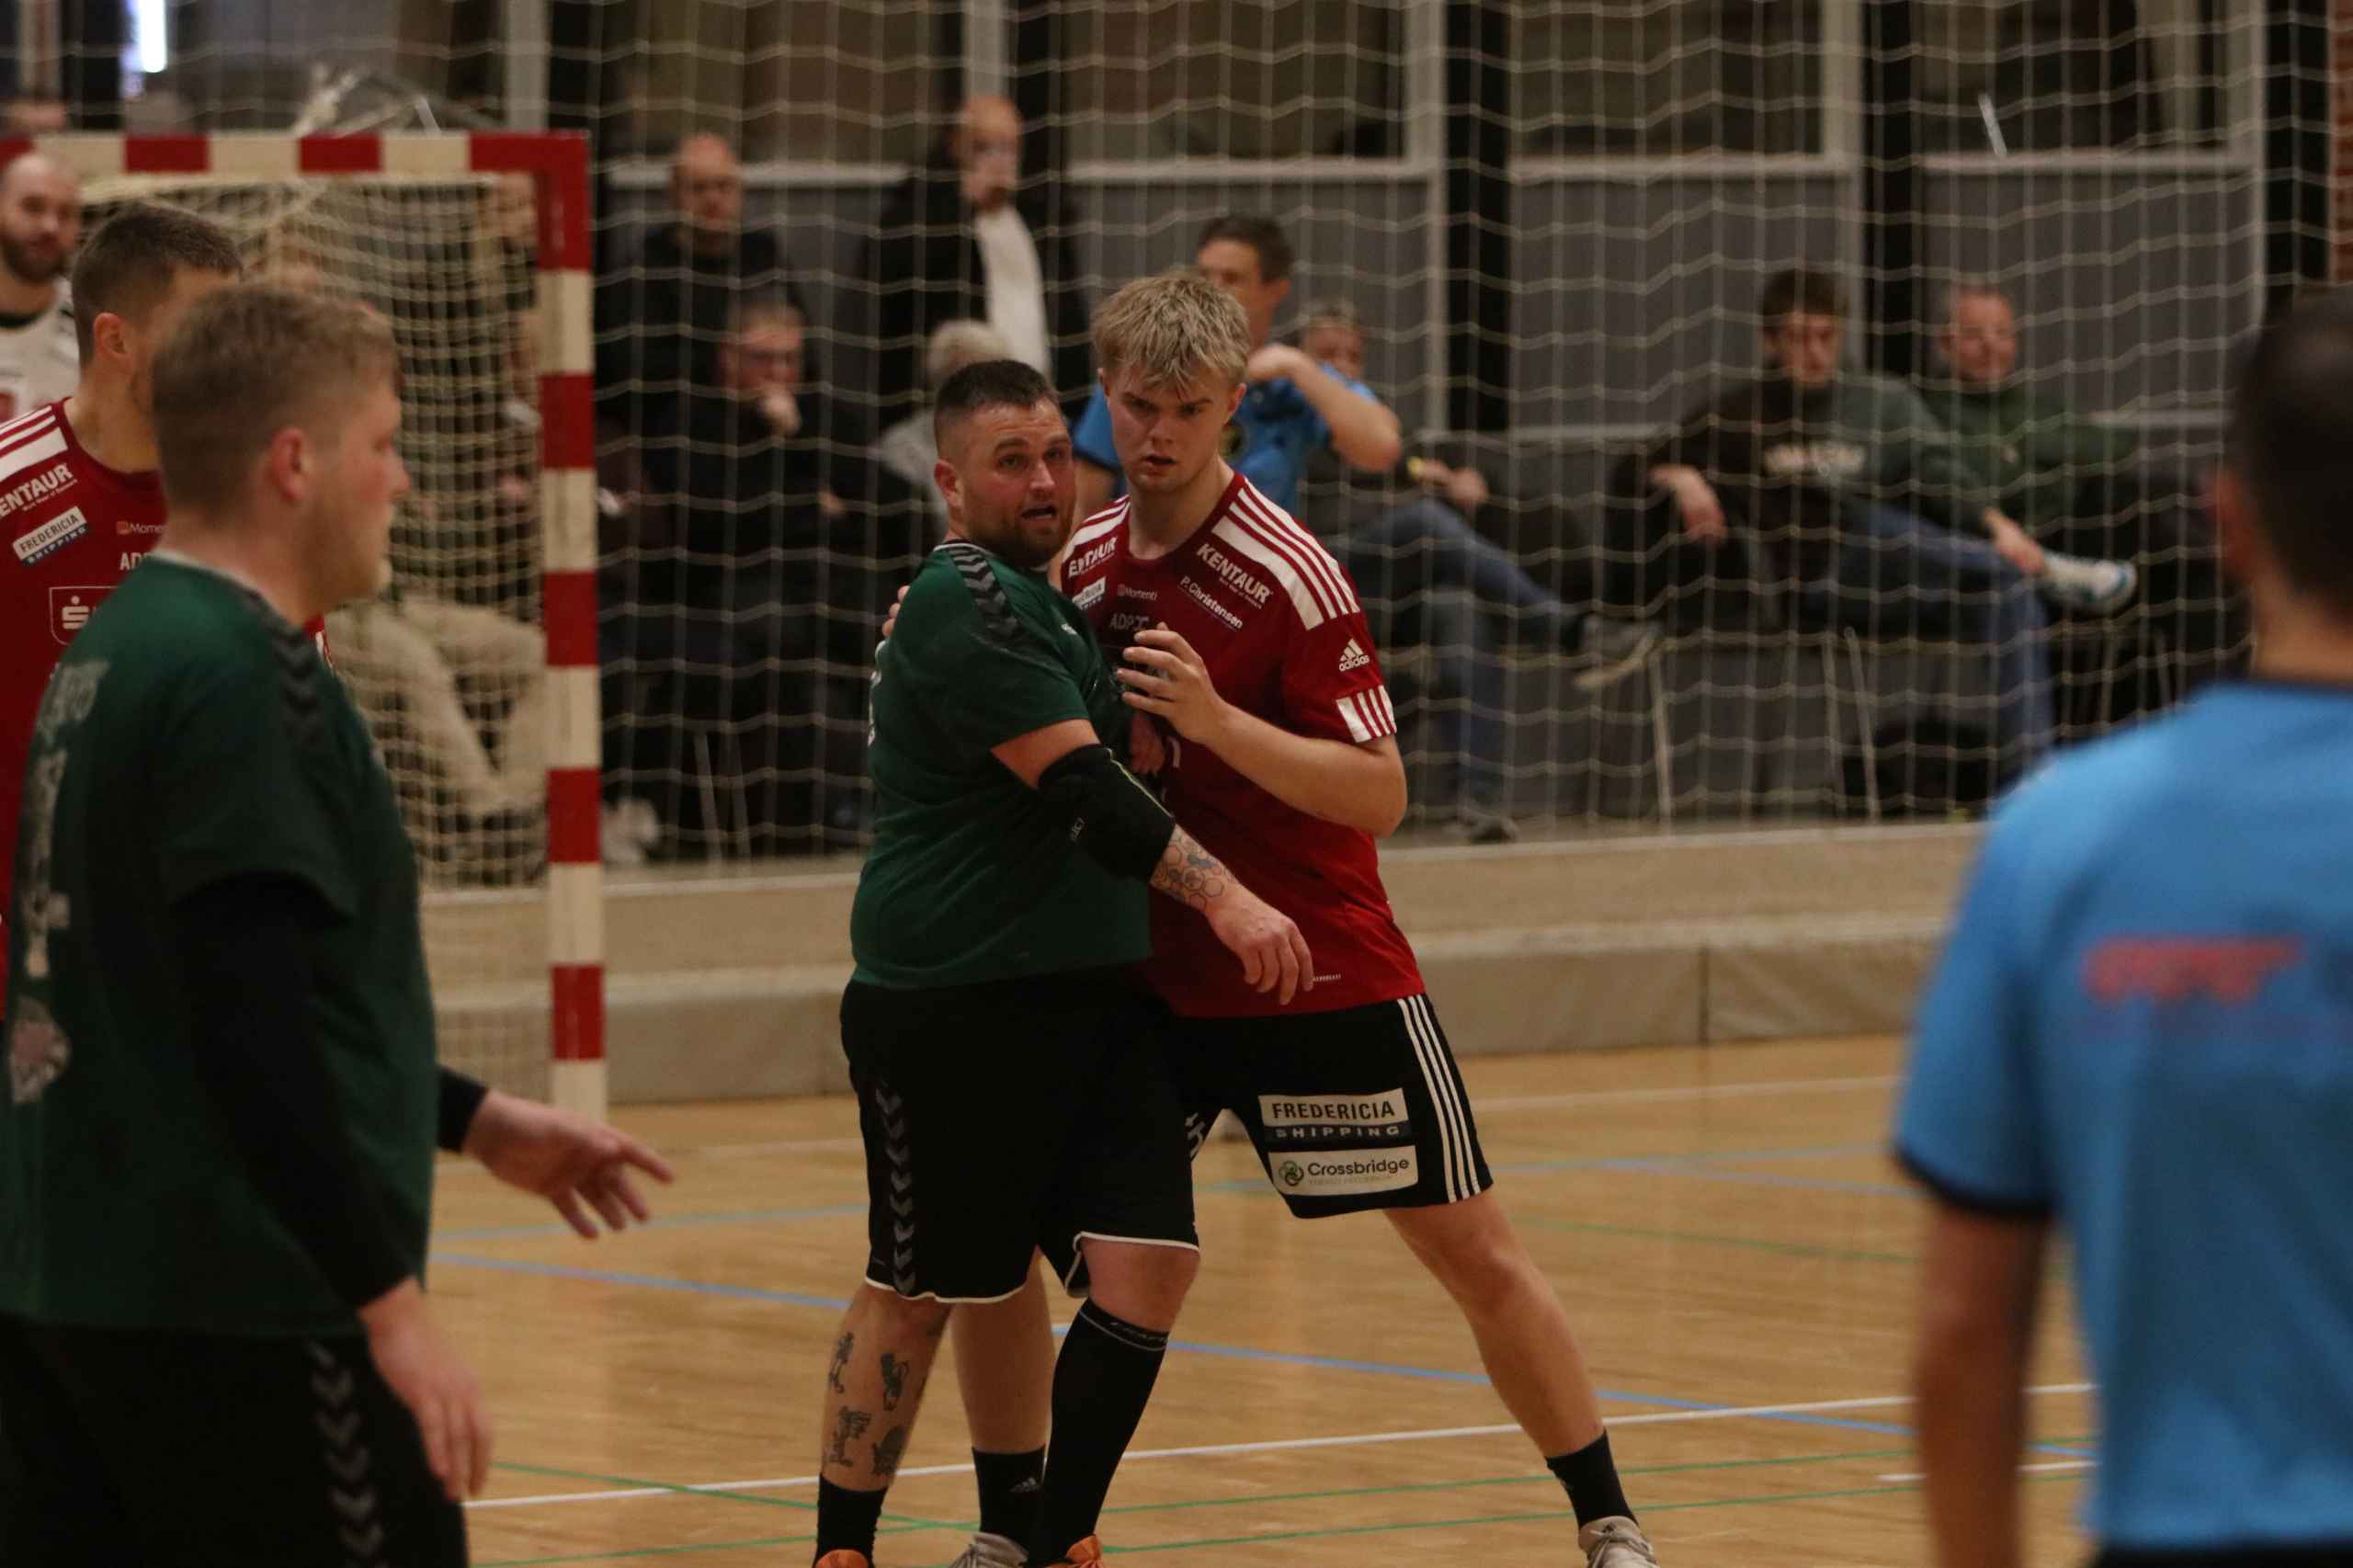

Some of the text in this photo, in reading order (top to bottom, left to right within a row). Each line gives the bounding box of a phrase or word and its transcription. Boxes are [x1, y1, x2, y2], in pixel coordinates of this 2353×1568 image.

[19, 514, 80, 553] FREDERICIA
[1197, 542, 1271, 604] KENTAUR
[1338, 653, 1370, 672] adidas
[1271, 1100, 1395, 1119] FREDERICIA
[1275, 1125, 1400, 1139] SHIPPING
[1307, 1158, 1410, 1176] Crossbridge
